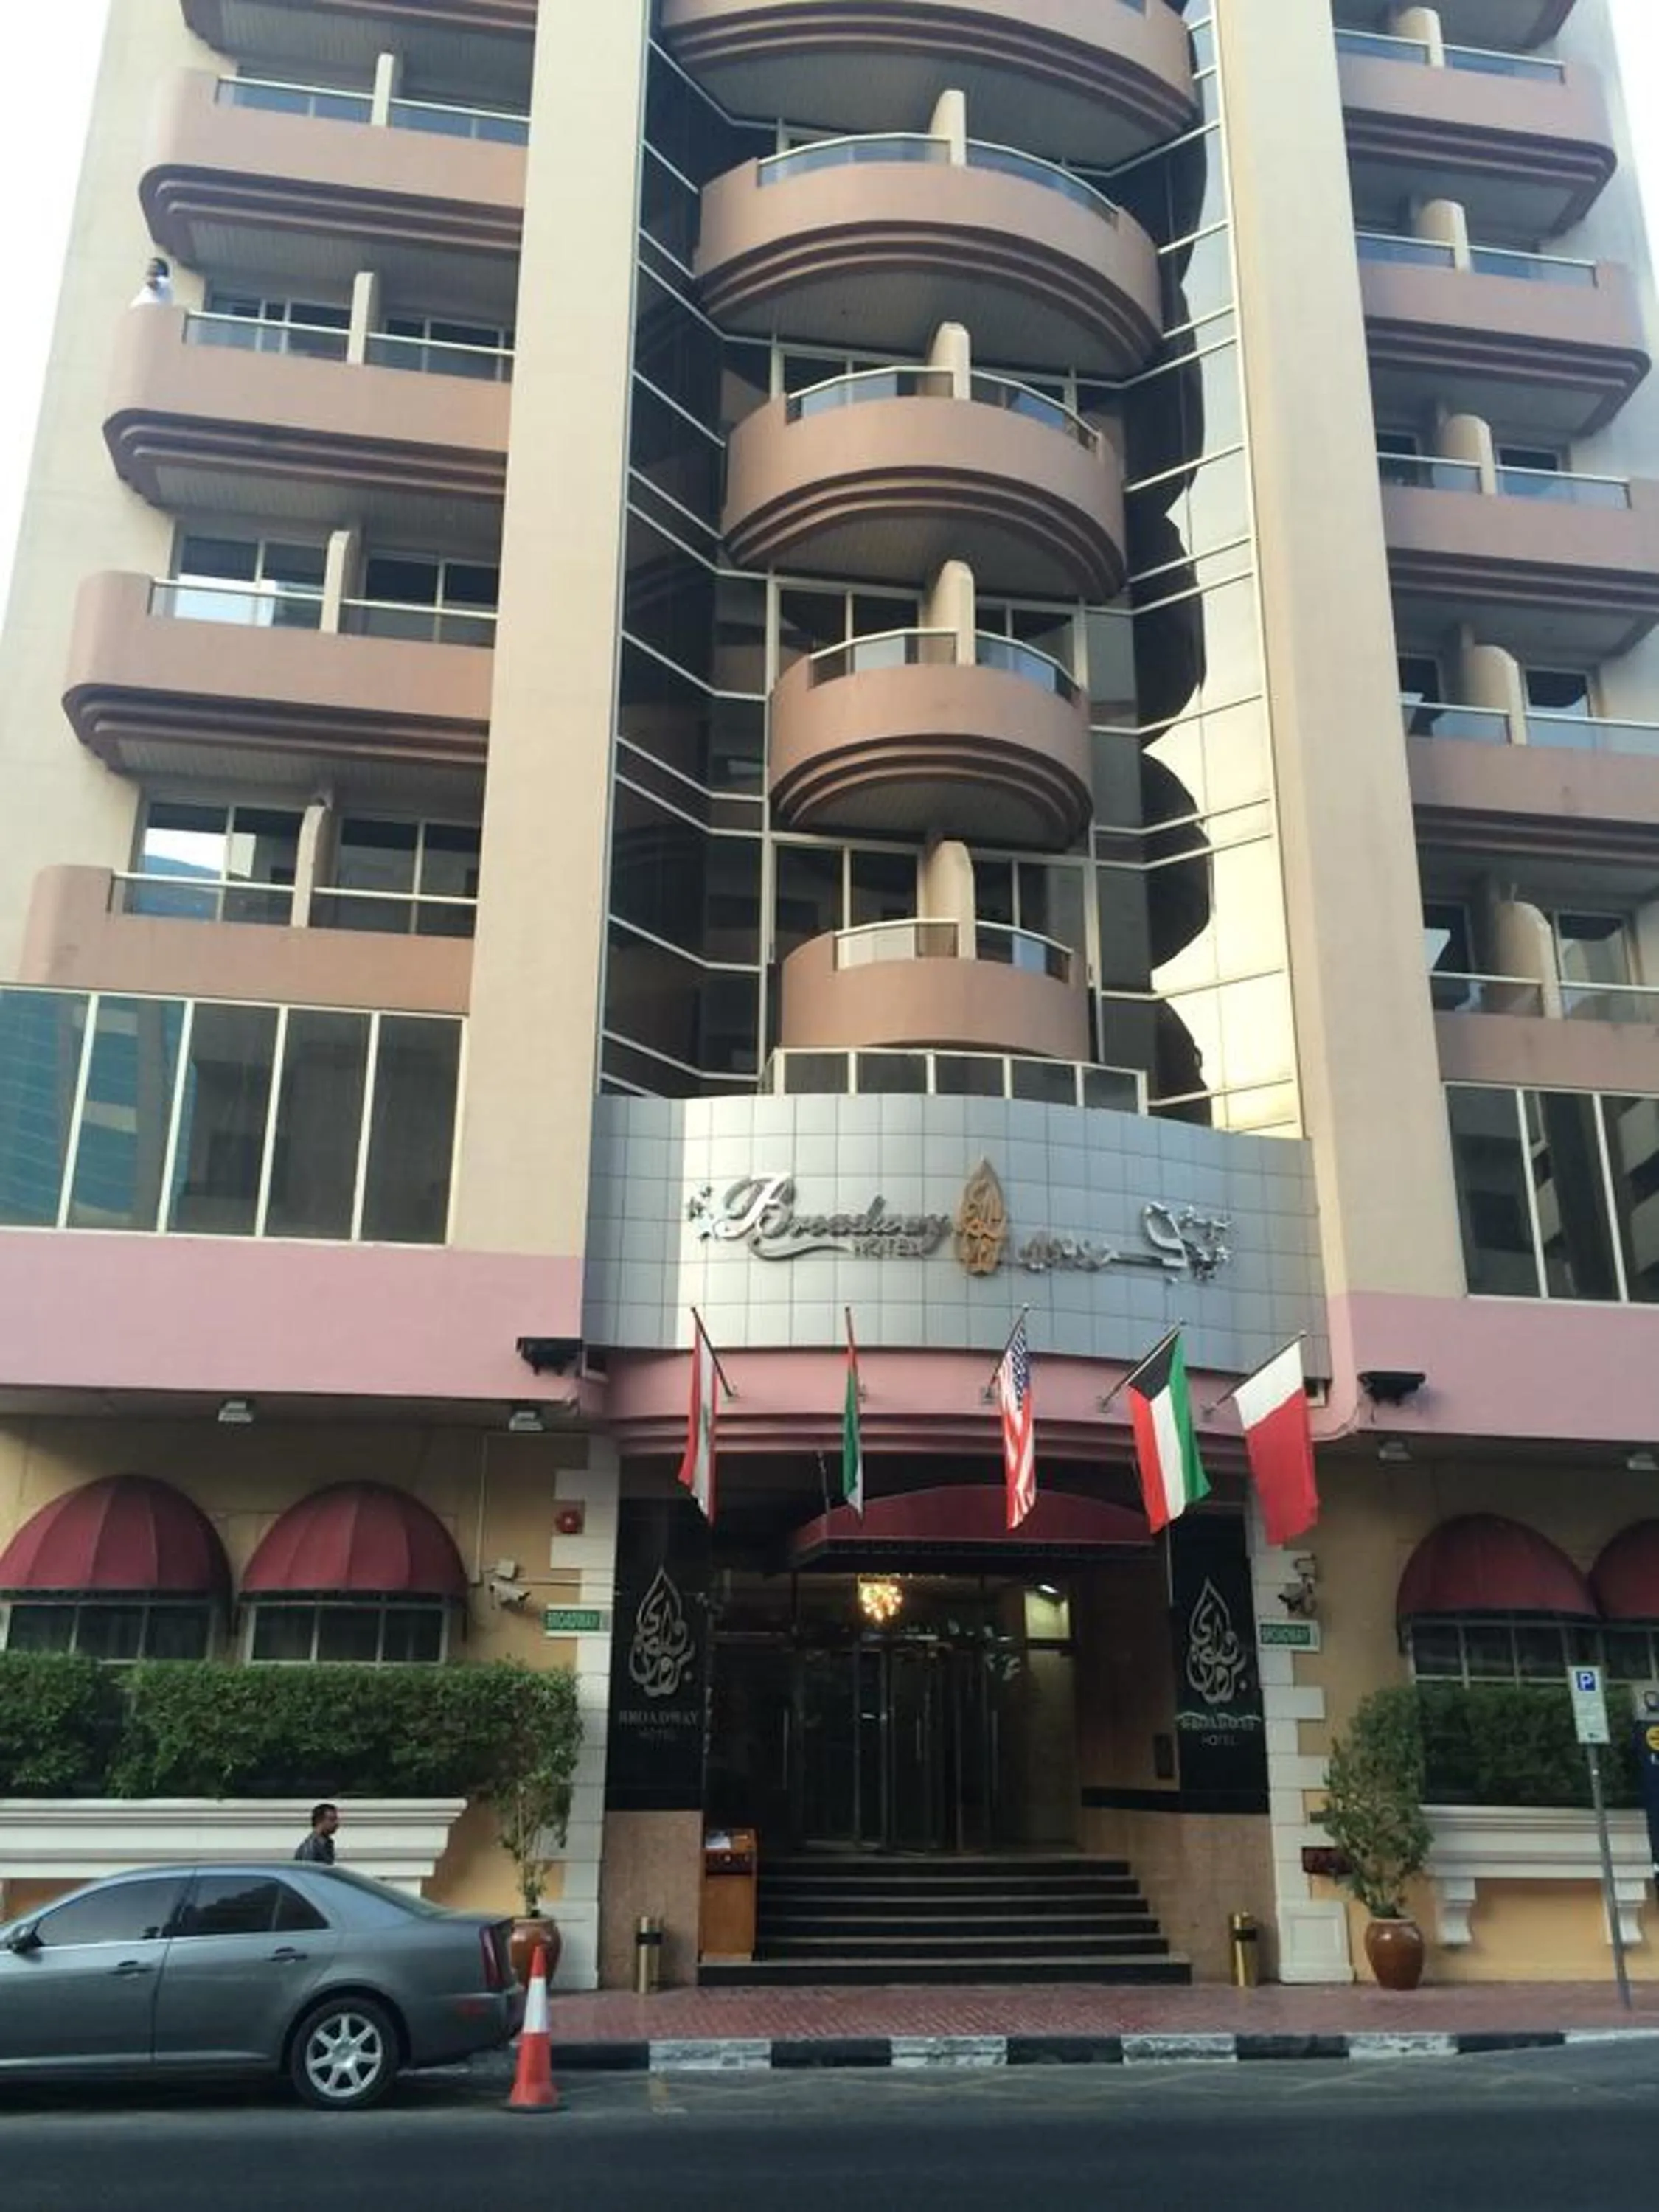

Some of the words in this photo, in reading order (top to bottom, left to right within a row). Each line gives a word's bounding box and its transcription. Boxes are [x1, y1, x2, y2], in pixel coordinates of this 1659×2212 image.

[712, 1172, 950, 1261] Broadway
[853, 1239, 921, 1259] HOTEL
[1580, 1672, 1593, 1691] P
[619, 1710, 700, 1726] BROADWAY
